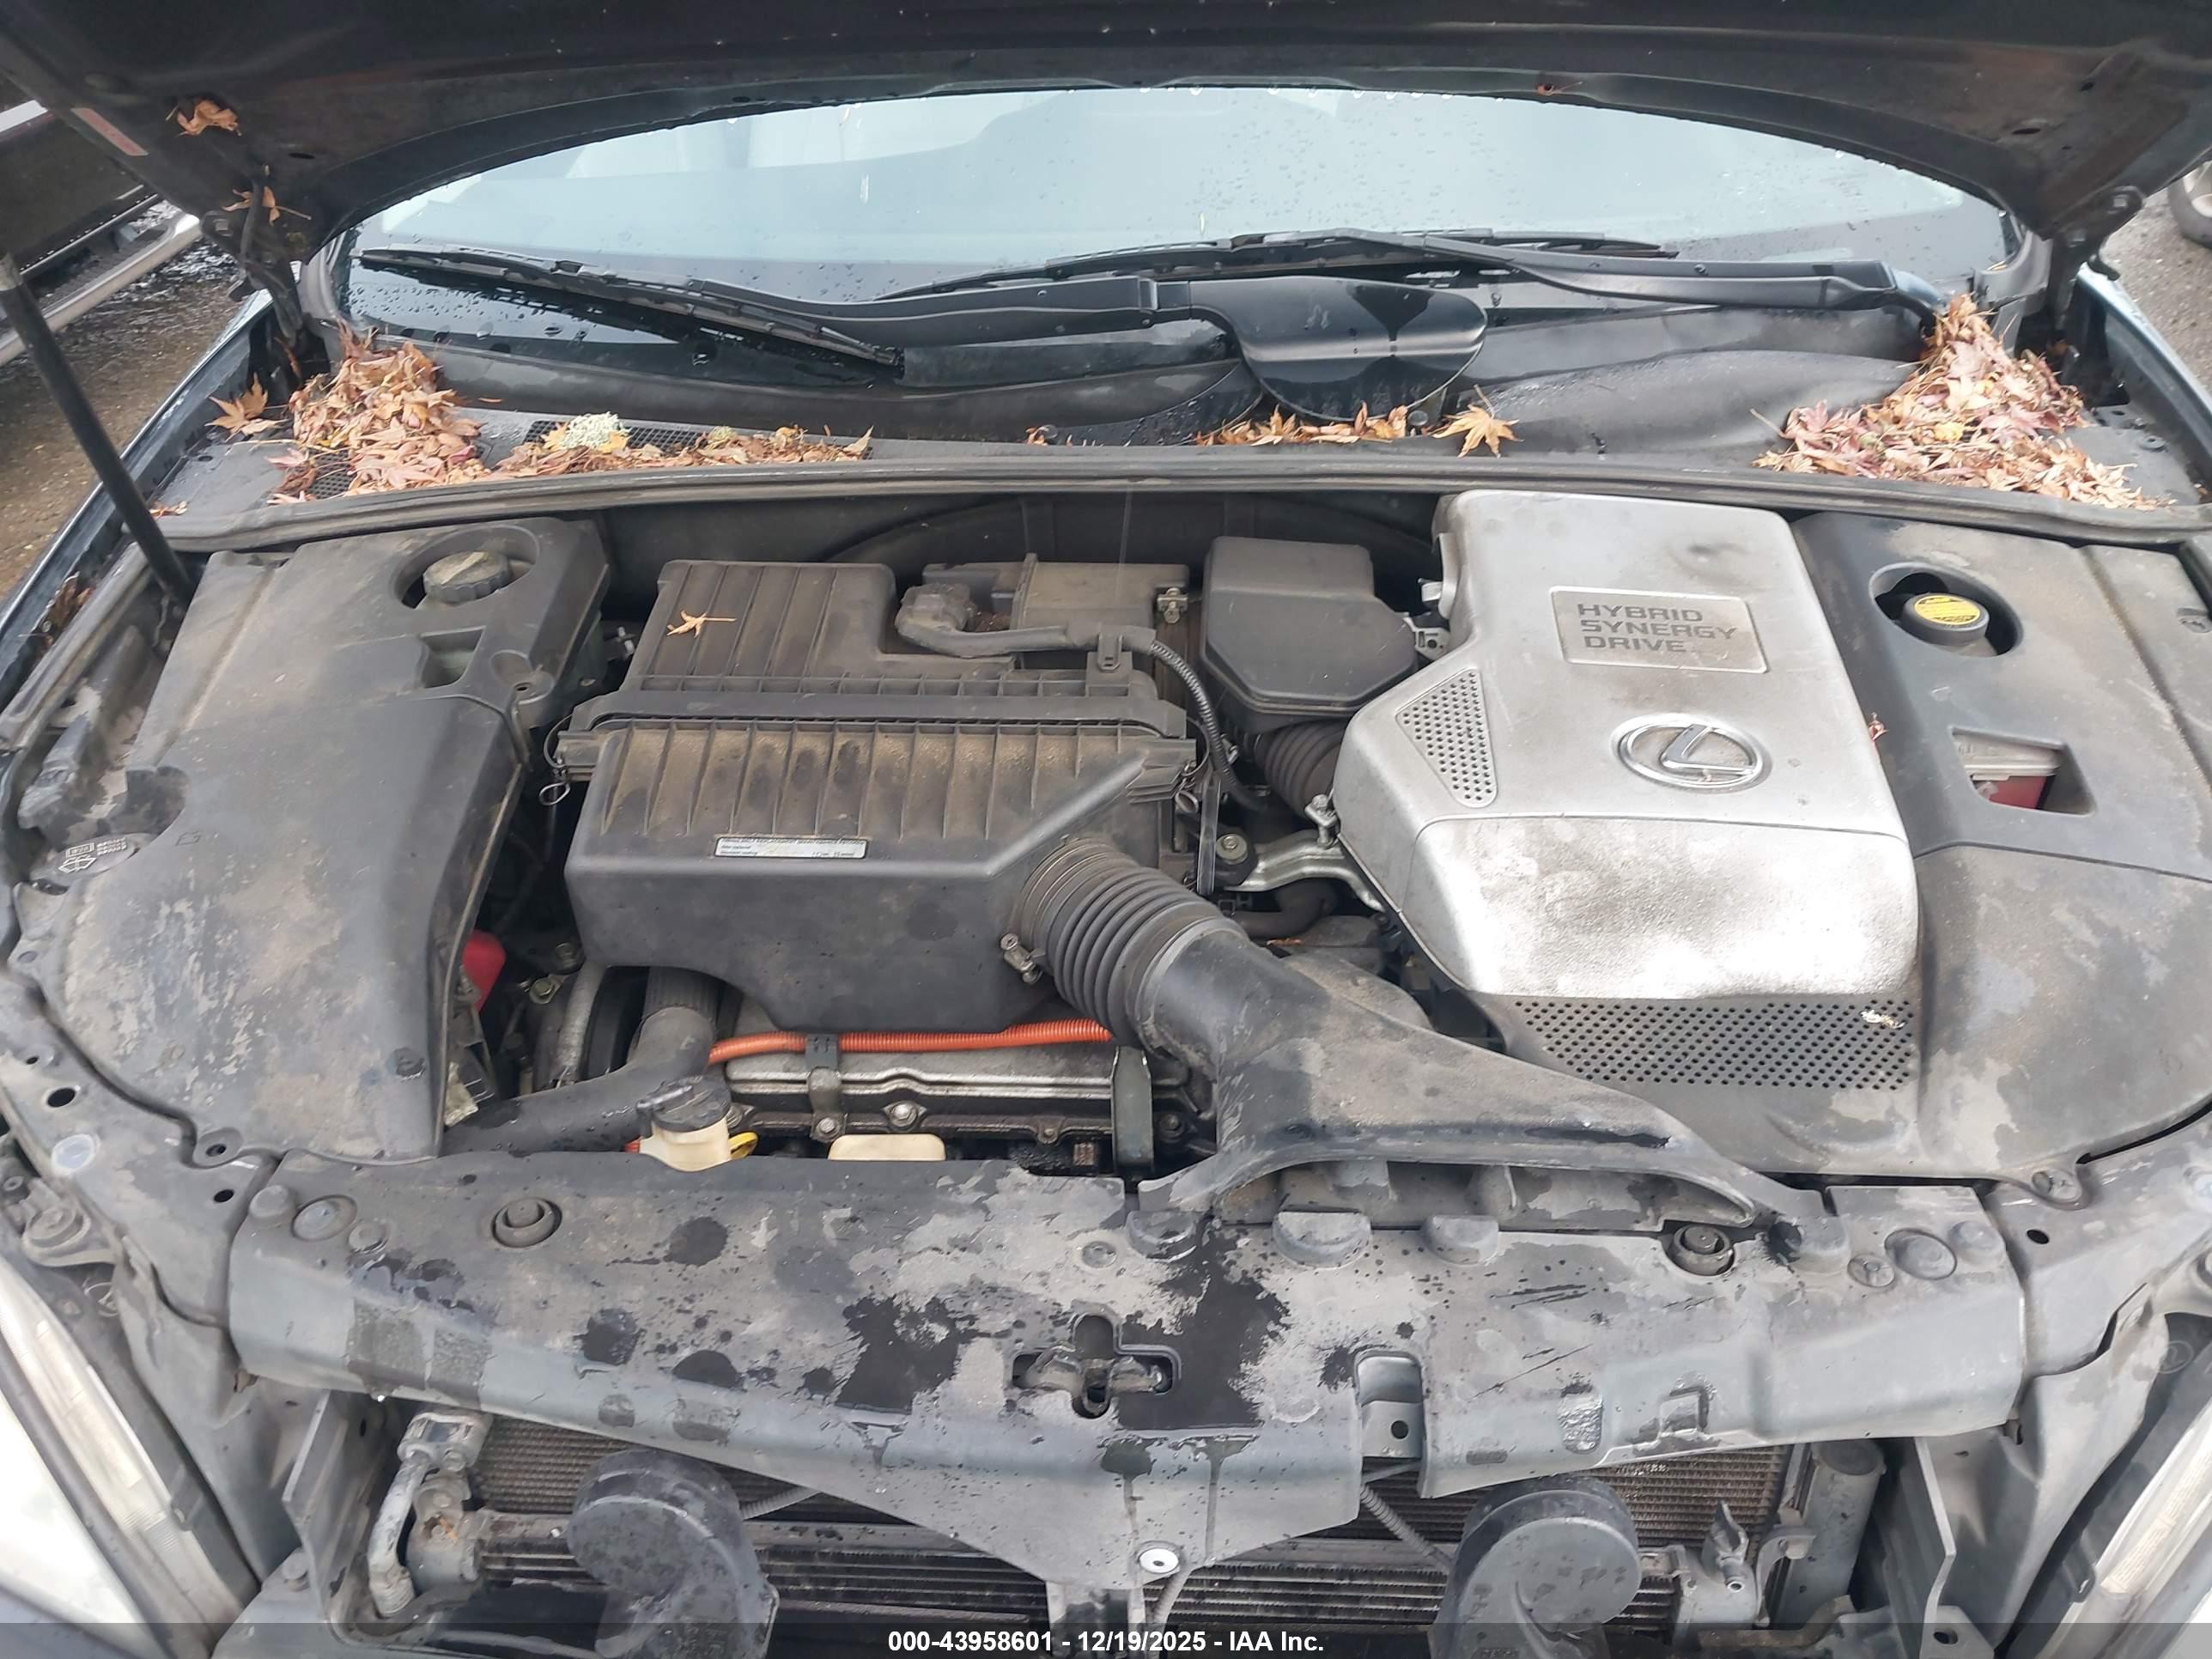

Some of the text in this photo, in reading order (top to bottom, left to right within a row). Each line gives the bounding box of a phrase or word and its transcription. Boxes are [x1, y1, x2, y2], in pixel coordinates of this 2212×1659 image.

[1577, 604, 1703, 622] HYBRID
[1580, 620, 1737, 640] SYNERGY
[1583, 635, 1686, 653] DRIVE
